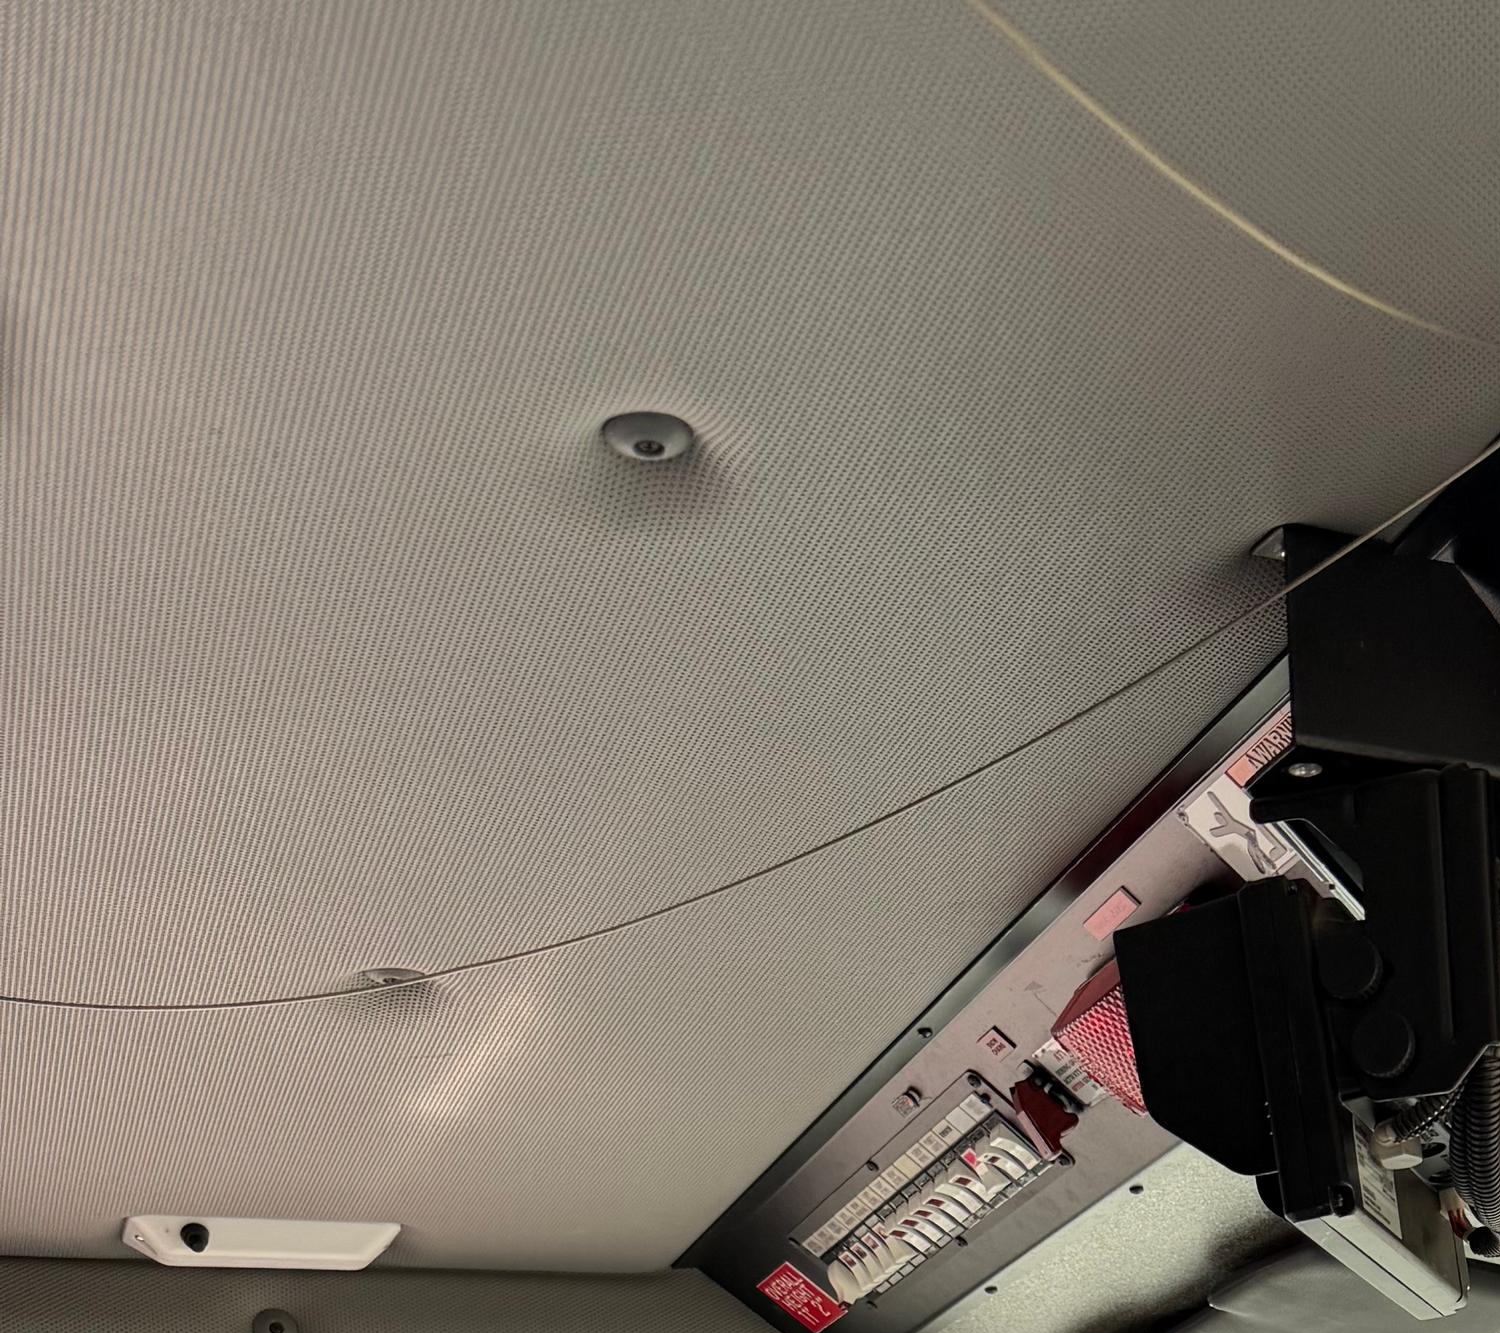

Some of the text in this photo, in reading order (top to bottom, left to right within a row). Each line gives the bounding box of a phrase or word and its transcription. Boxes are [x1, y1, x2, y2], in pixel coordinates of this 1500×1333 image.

[1252, 716, 1292, 761] WARN
[765, 1271, 804, 1300] OVERALL
[781, 1284, 815, 1311] HEIGHT
